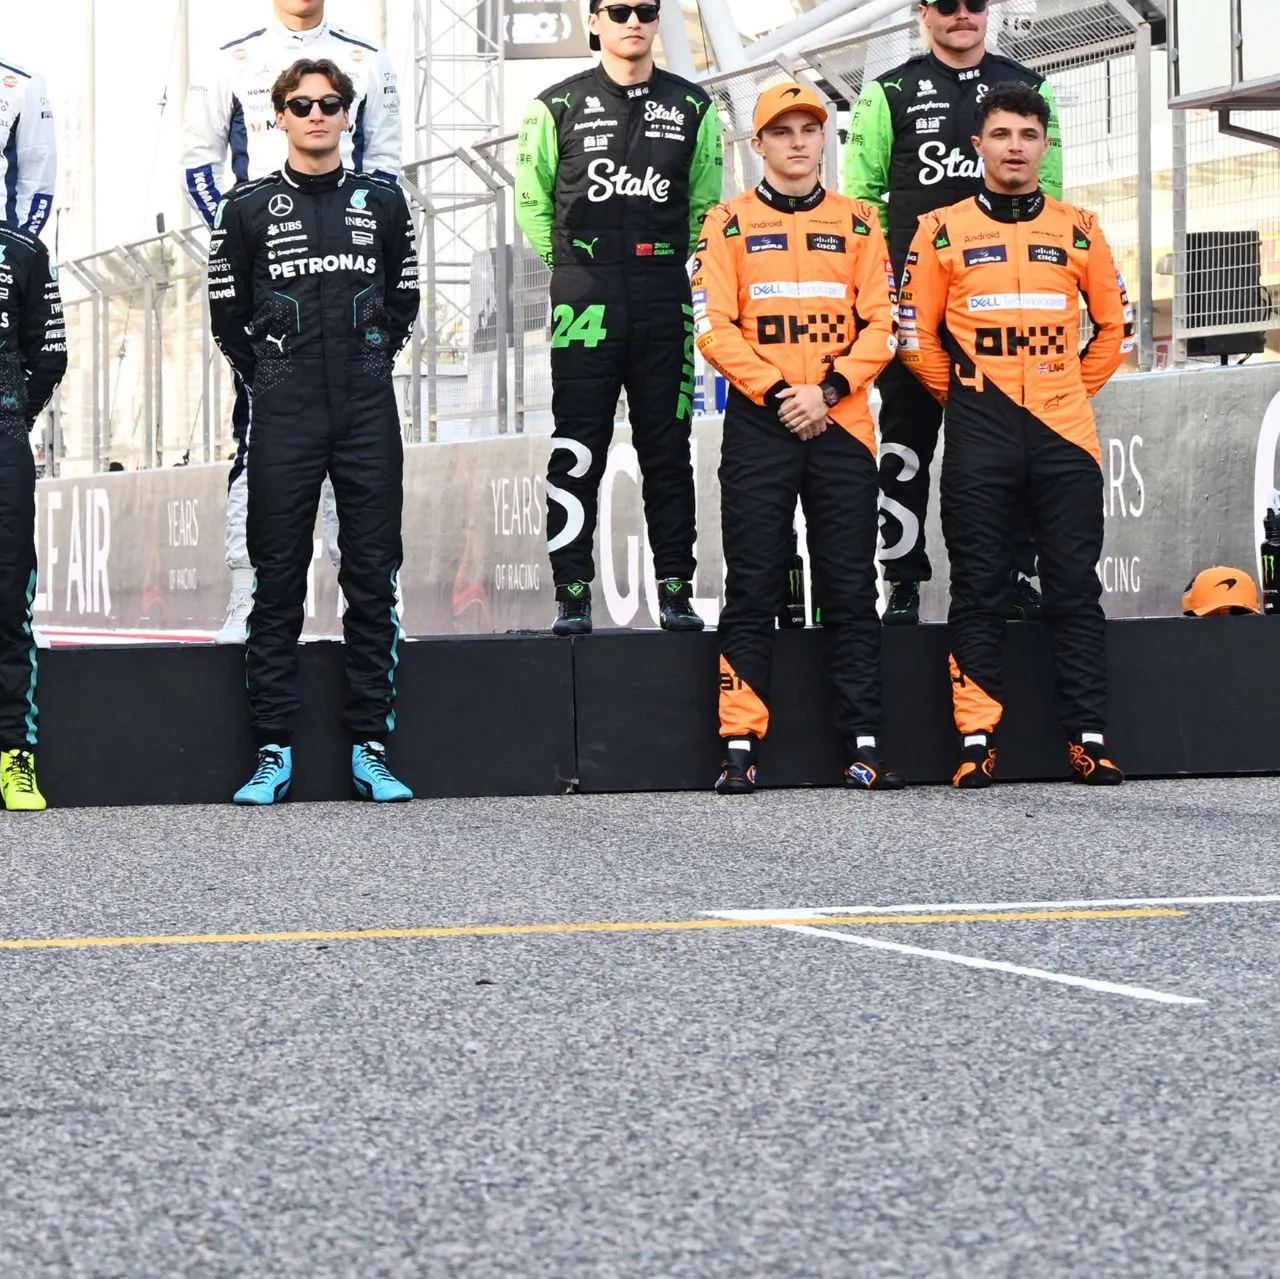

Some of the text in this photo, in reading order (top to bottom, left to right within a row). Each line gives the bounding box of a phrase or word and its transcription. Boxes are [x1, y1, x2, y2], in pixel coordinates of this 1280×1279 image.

[645, 101, 685, 125] Stake
[587, 158, 671, 202] Stake
[279, 221, 303, 232] UBS
[345, 216, 377, 229] INEOS
[964, 230, 1001, 243] Android
[269, 253, 376, 280] PETRONAS
[1037, 254, 1057, 262] CISCO
[753, 283, 783, 295] DELL
[971, 297, 1001, 308] DELL
[551, 304, 607, 348] 24
[757, 314, 845, 344] OKX
[975, 326, 1064, 356] OKX
[1048, 363, 1064, 372] LN4
[491, 475, 542, 536] YEARS
[167, 499, 199, 546] YEARS
[66, 484, 111, 617] AIR
[495, 562, 540, 591] OF RACING
